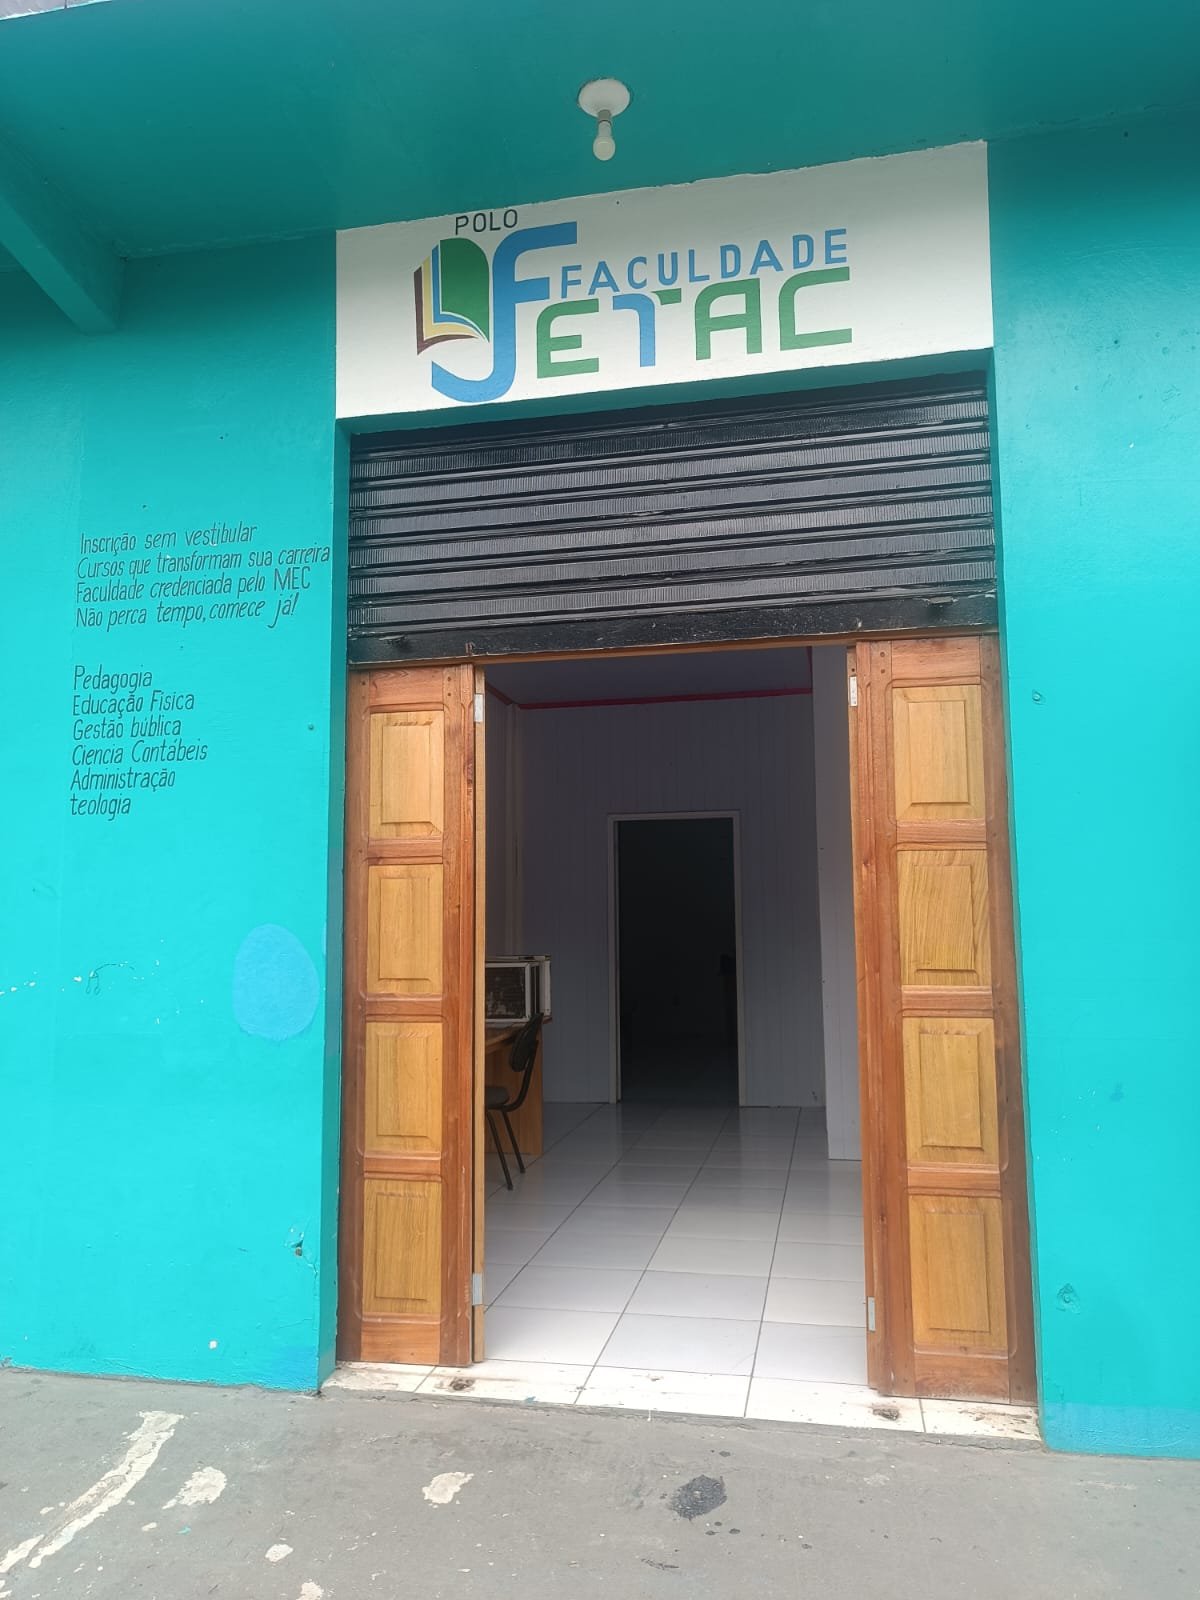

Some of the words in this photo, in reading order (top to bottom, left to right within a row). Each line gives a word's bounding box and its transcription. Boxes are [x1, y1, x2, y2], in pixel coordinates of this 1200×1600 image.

[455, 208, 519, 235] POLO
[561, 228, 848, 298] FACULDADE
[80, 532, 136, 556] Inscrição
[144, 531, 177, 549] sem
[185, 521, 257, 547] vestibular
[77, 557, 124, 578] Cursos
[128, 558, 151, 580] que
[157, 551, 242, 574] transformam
[248, 548, 273, 567] sua
[278, 543, 330, 565] carreira
[76, 579, 145, 603] Faculdade
[150, 575, 232, 599] credenciada
[237, 571, 265, 598] pelo
[273, 566, 311, 591] MEC
[76, 607, 103, 628] Não
[107, 608, 147, 632] perca
[267, 592, 299, 629] já!
[74, 664, 152, 694] Pedagogia
[73, 694, 143, 719] Educação
[73, 717, 123, 741] Gestão
[131, 738, 208, 763] Contábeis
[70, 767, 176, 792] Administração
[70, 792, 131, 821] teologia
